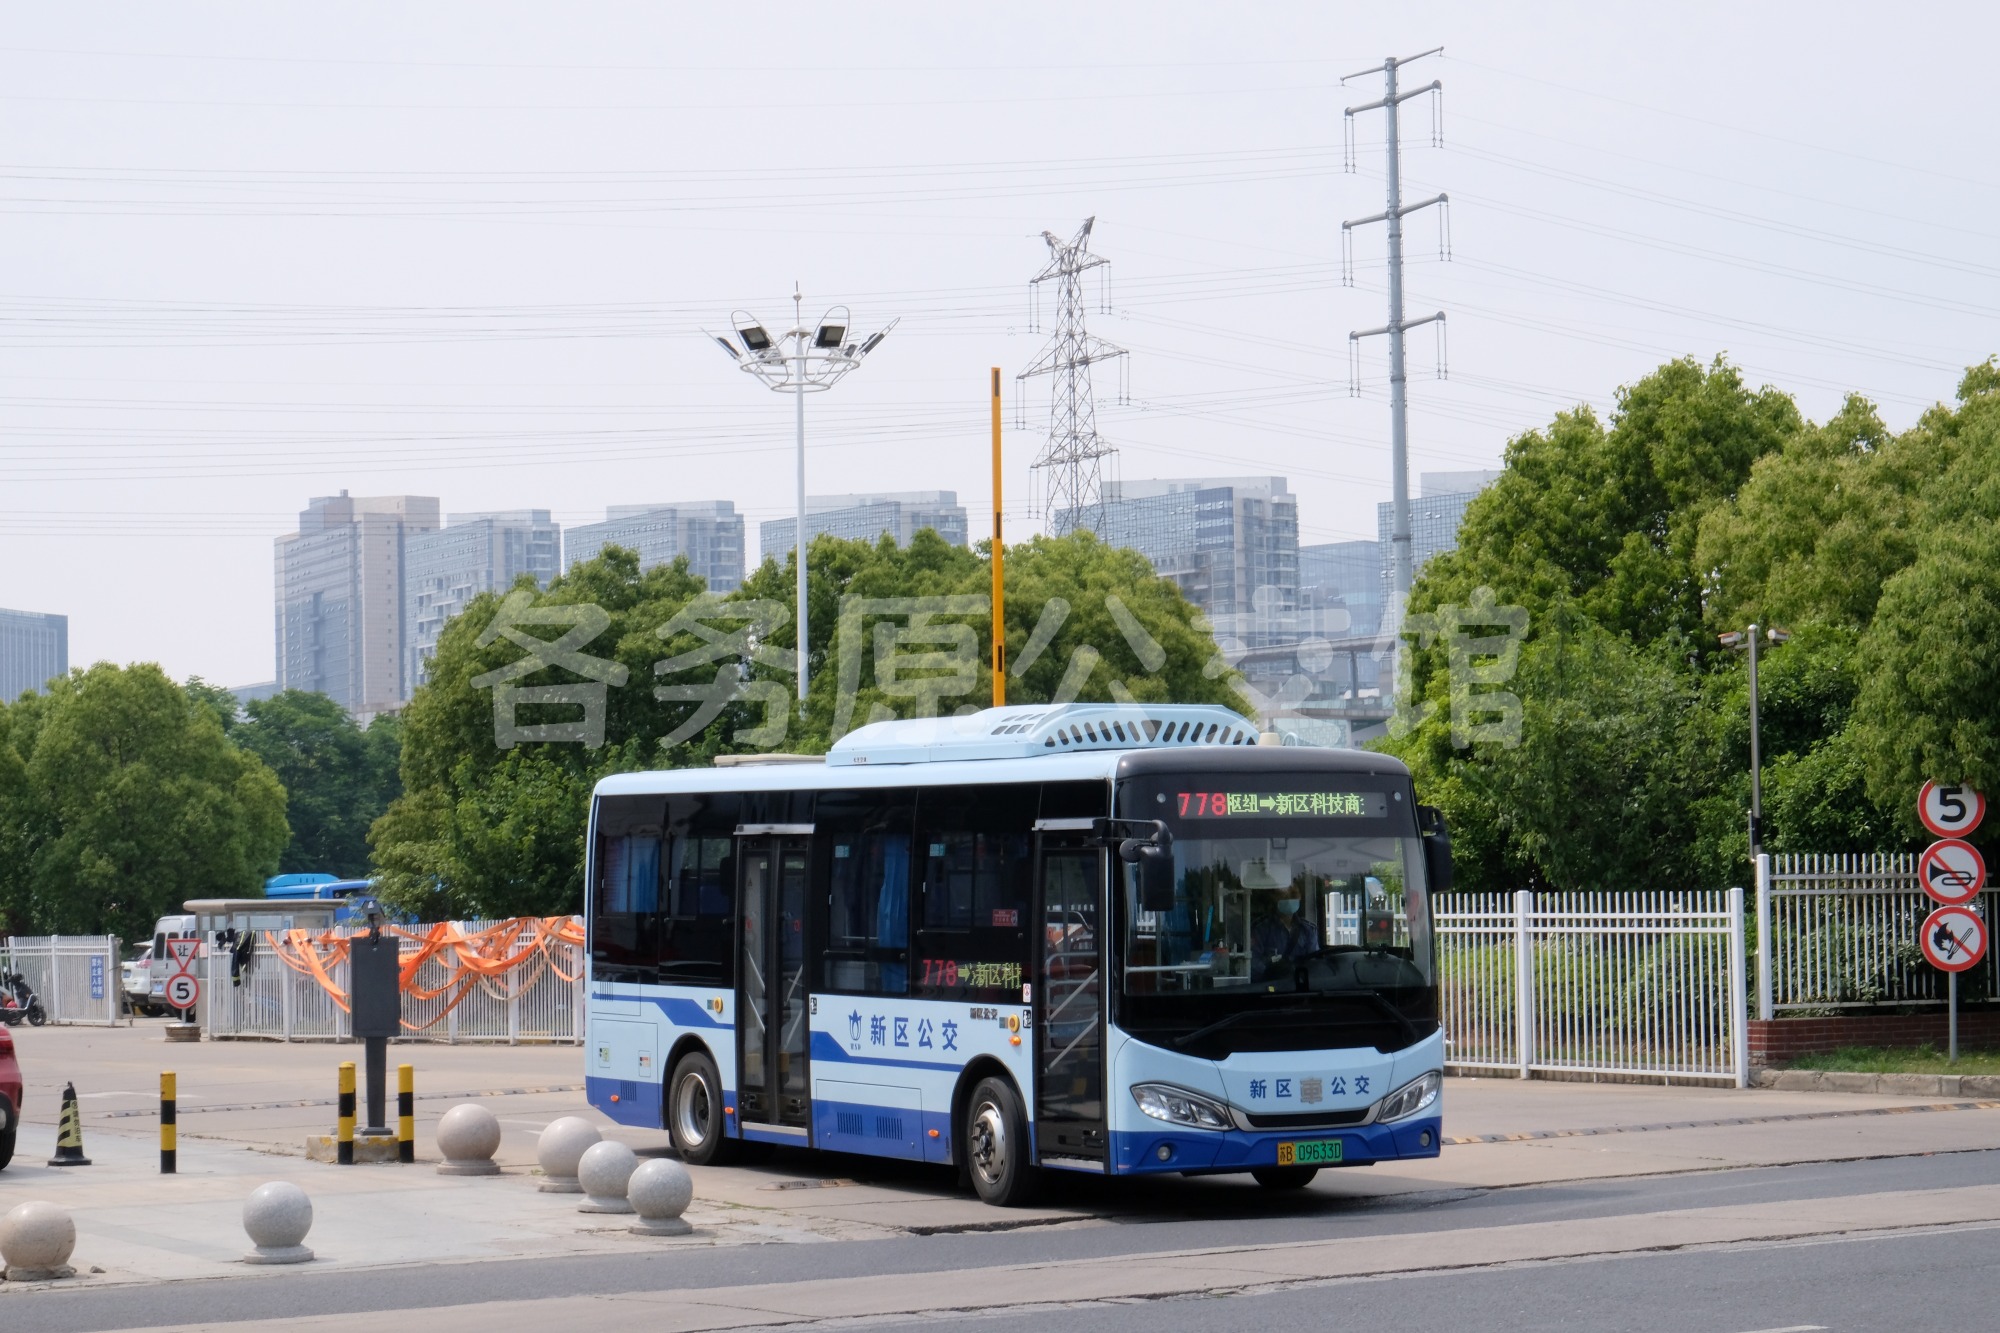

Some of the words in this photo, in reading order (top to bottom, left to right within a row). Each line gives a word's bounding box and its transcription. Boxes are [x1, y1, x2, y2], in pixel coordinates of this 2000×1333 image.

[1178, 793, 1227, 816] 778
[1275, 793, 1365, 816] 新区科技商
[1940, 787, 1967, 823] 5
[177, 944, 189, 957] 让
[922, 959, 957, 987] 778
[176, 982, 190, 1000] 5
[870, 1014, 958, 1052] 新区公交
